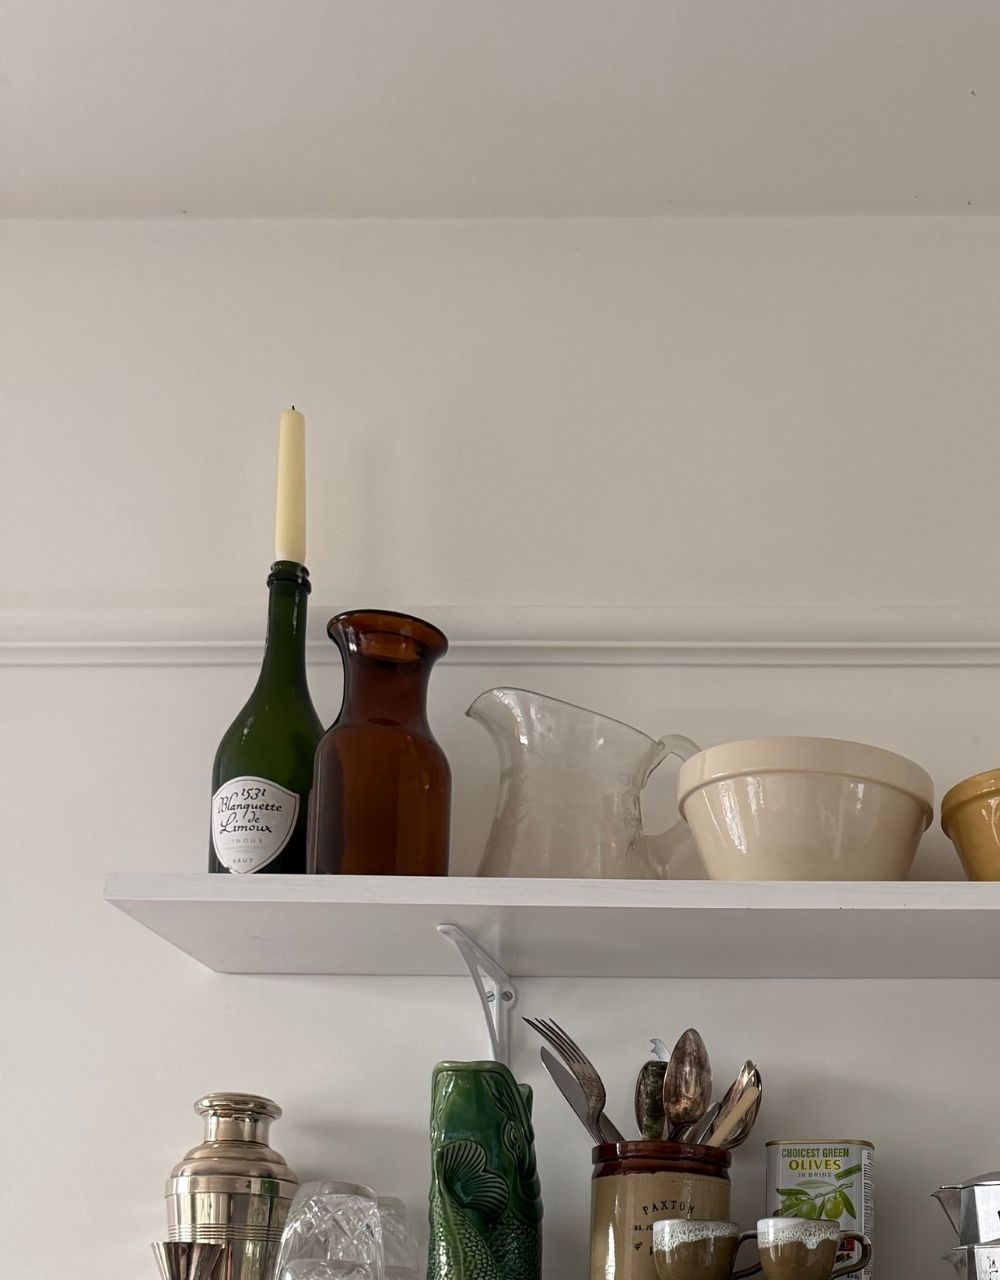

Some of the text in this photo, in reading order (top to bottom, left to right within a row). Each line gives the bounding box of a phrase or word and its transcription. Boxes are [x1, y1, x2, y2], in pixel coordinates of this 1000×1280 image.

[241, 788, 267, 800] 1531
[218, 792, 283, 819] Blanquette
[220, 812, 273, 834] Limoux
[781, 1148, 849, 1158] CHOICEST GREEN
[788, 1159, 842, 1171] OLIVES
[642, 1200, 695, 1215] PAXTON
